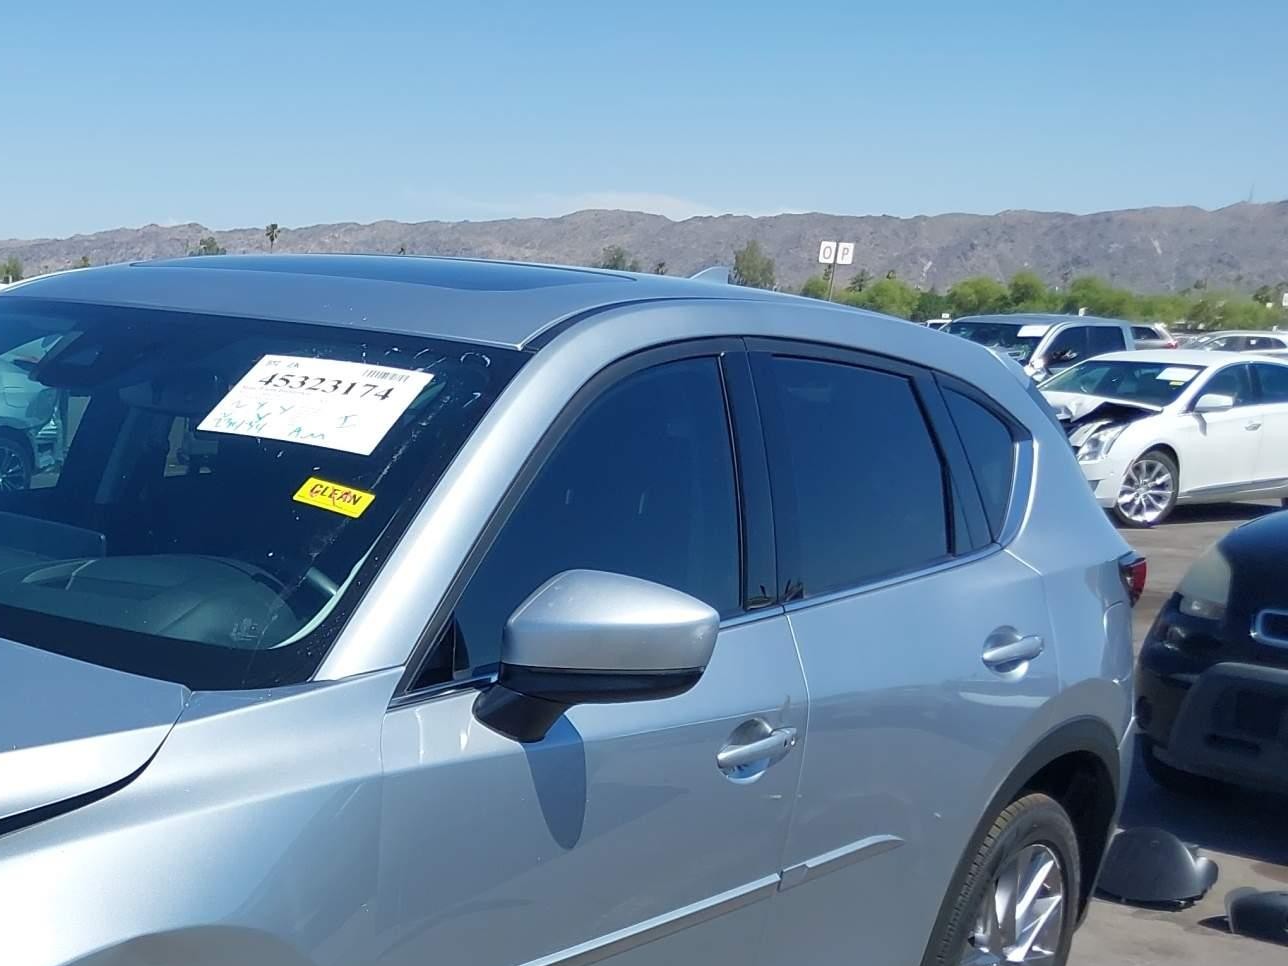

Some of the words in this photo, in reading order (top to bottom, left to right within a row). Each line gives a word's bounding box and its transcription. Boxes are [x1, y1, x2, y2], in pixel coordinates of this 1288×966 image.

[841, 247, 850, 260] P
[258, 373, 394, 401] 45323174
[310, 483, 362, 506] CLEAN
